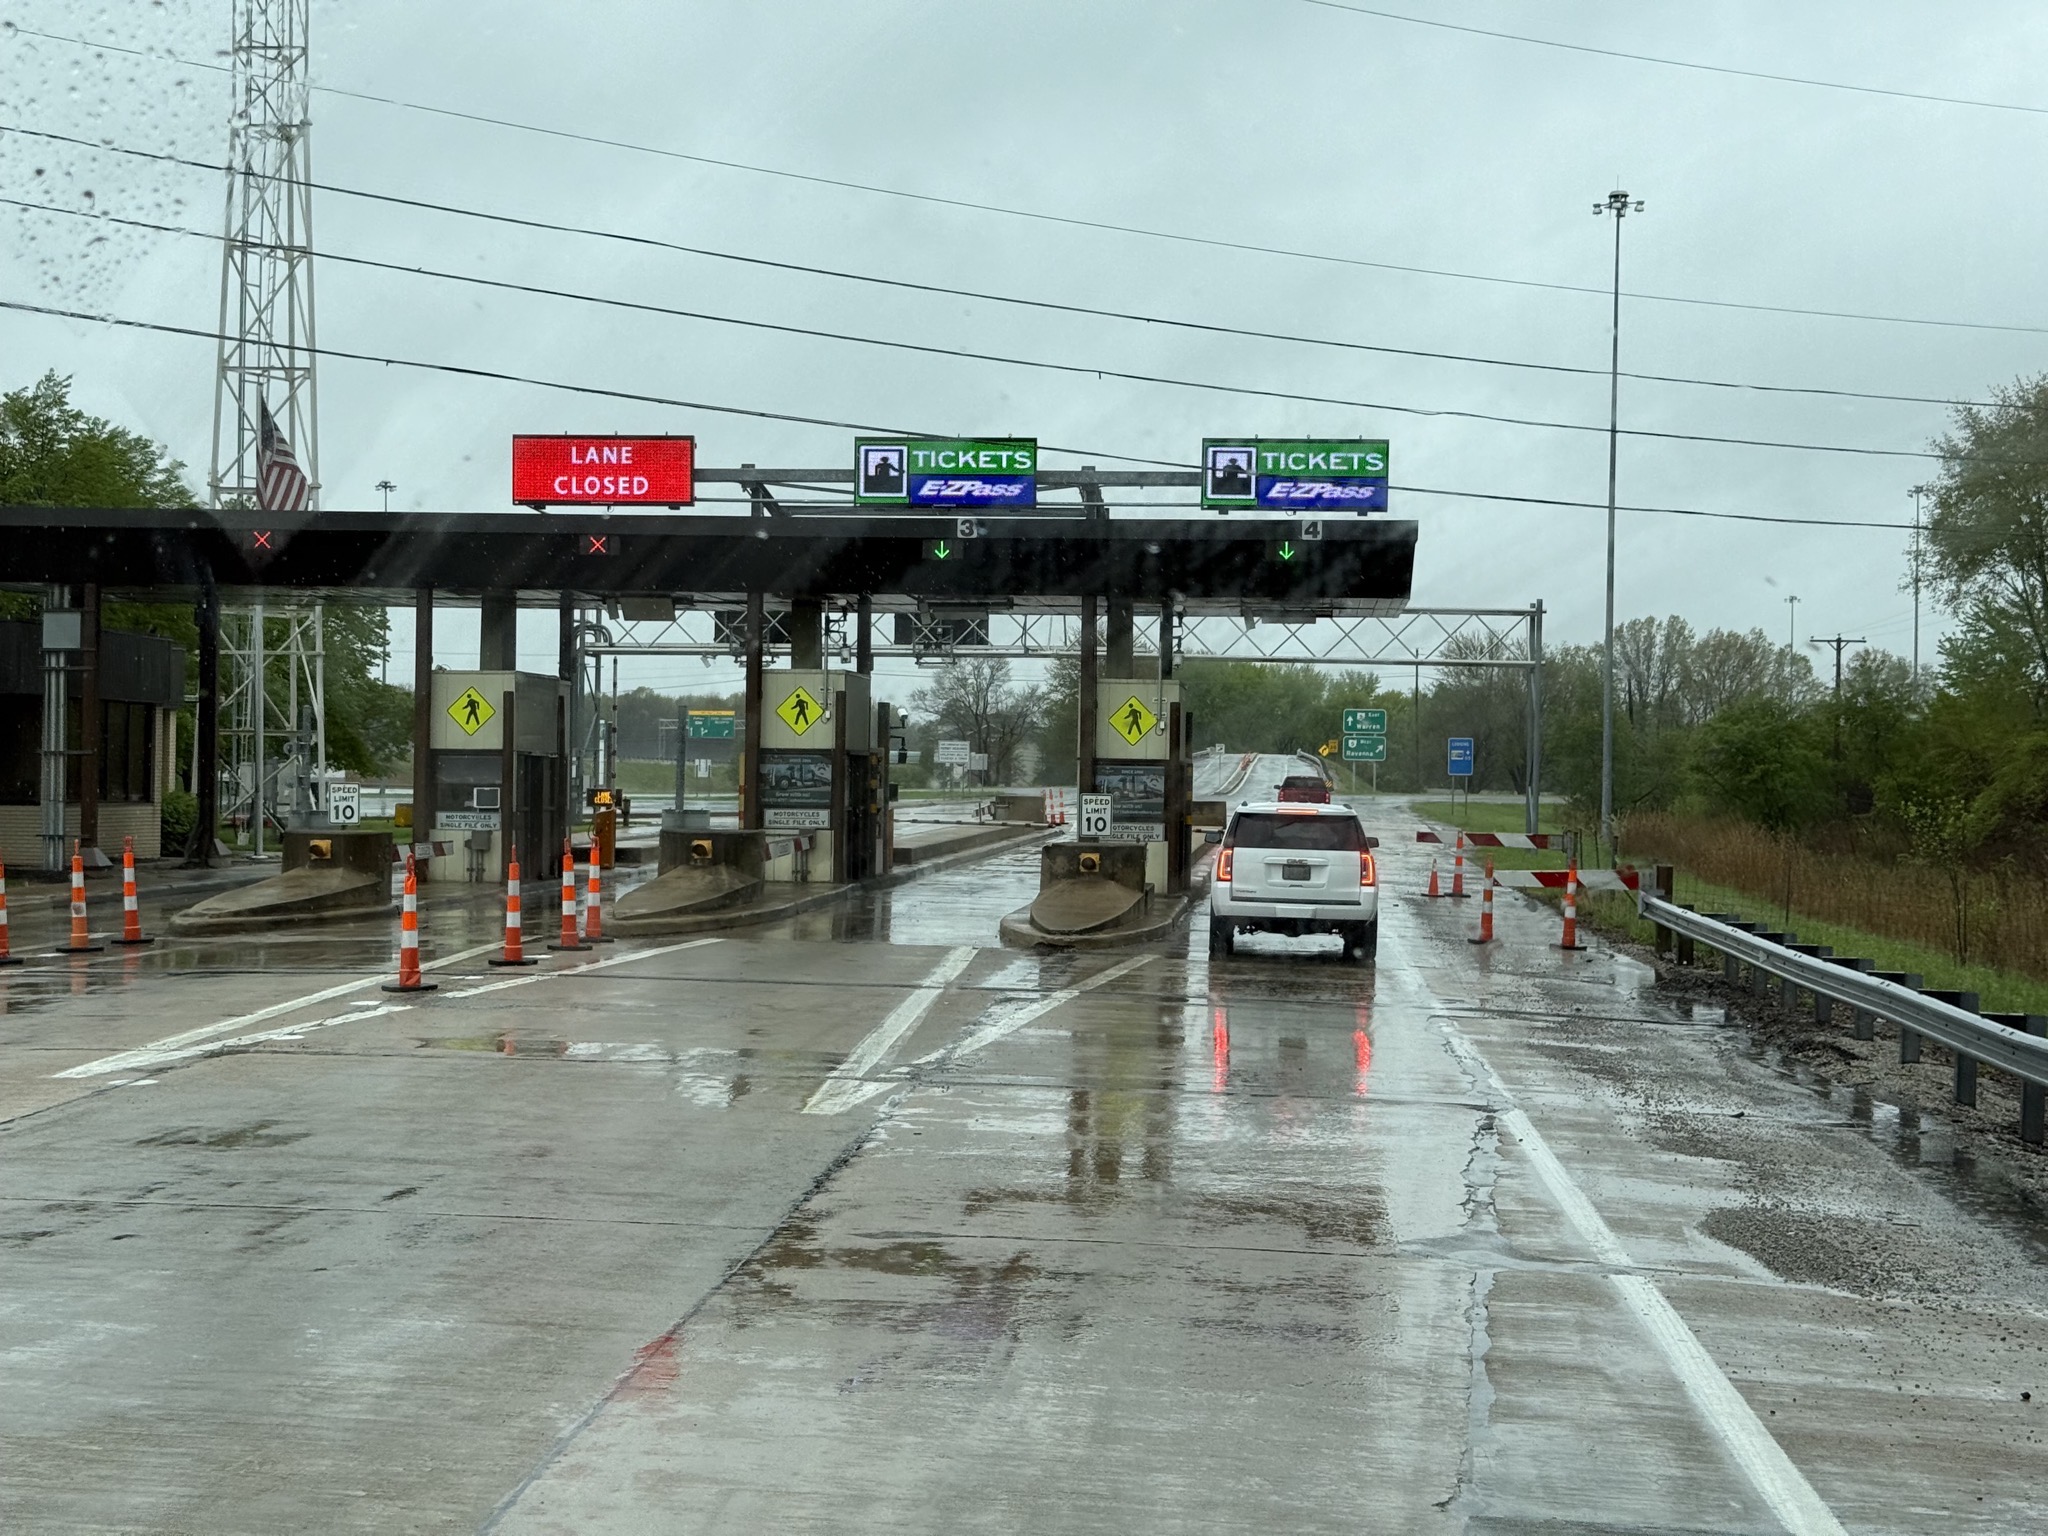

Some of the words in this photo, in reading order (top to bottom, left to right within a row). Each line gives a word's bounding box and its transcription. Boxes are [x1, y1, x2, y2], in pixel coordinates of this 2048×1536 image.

[571, 446, 633, 465] LANE
[912, 451, 1032, 469] TICKETS
[1261, 453, 1384, 470] TICKETS
[553, 476, 649, 495] CLOSED
[959, 520, 975, 537] 3
[1304, 522, 1320, 539] 4
[334, 805, 355, 820] 10
[1085, 816, 1107, 832] 10
